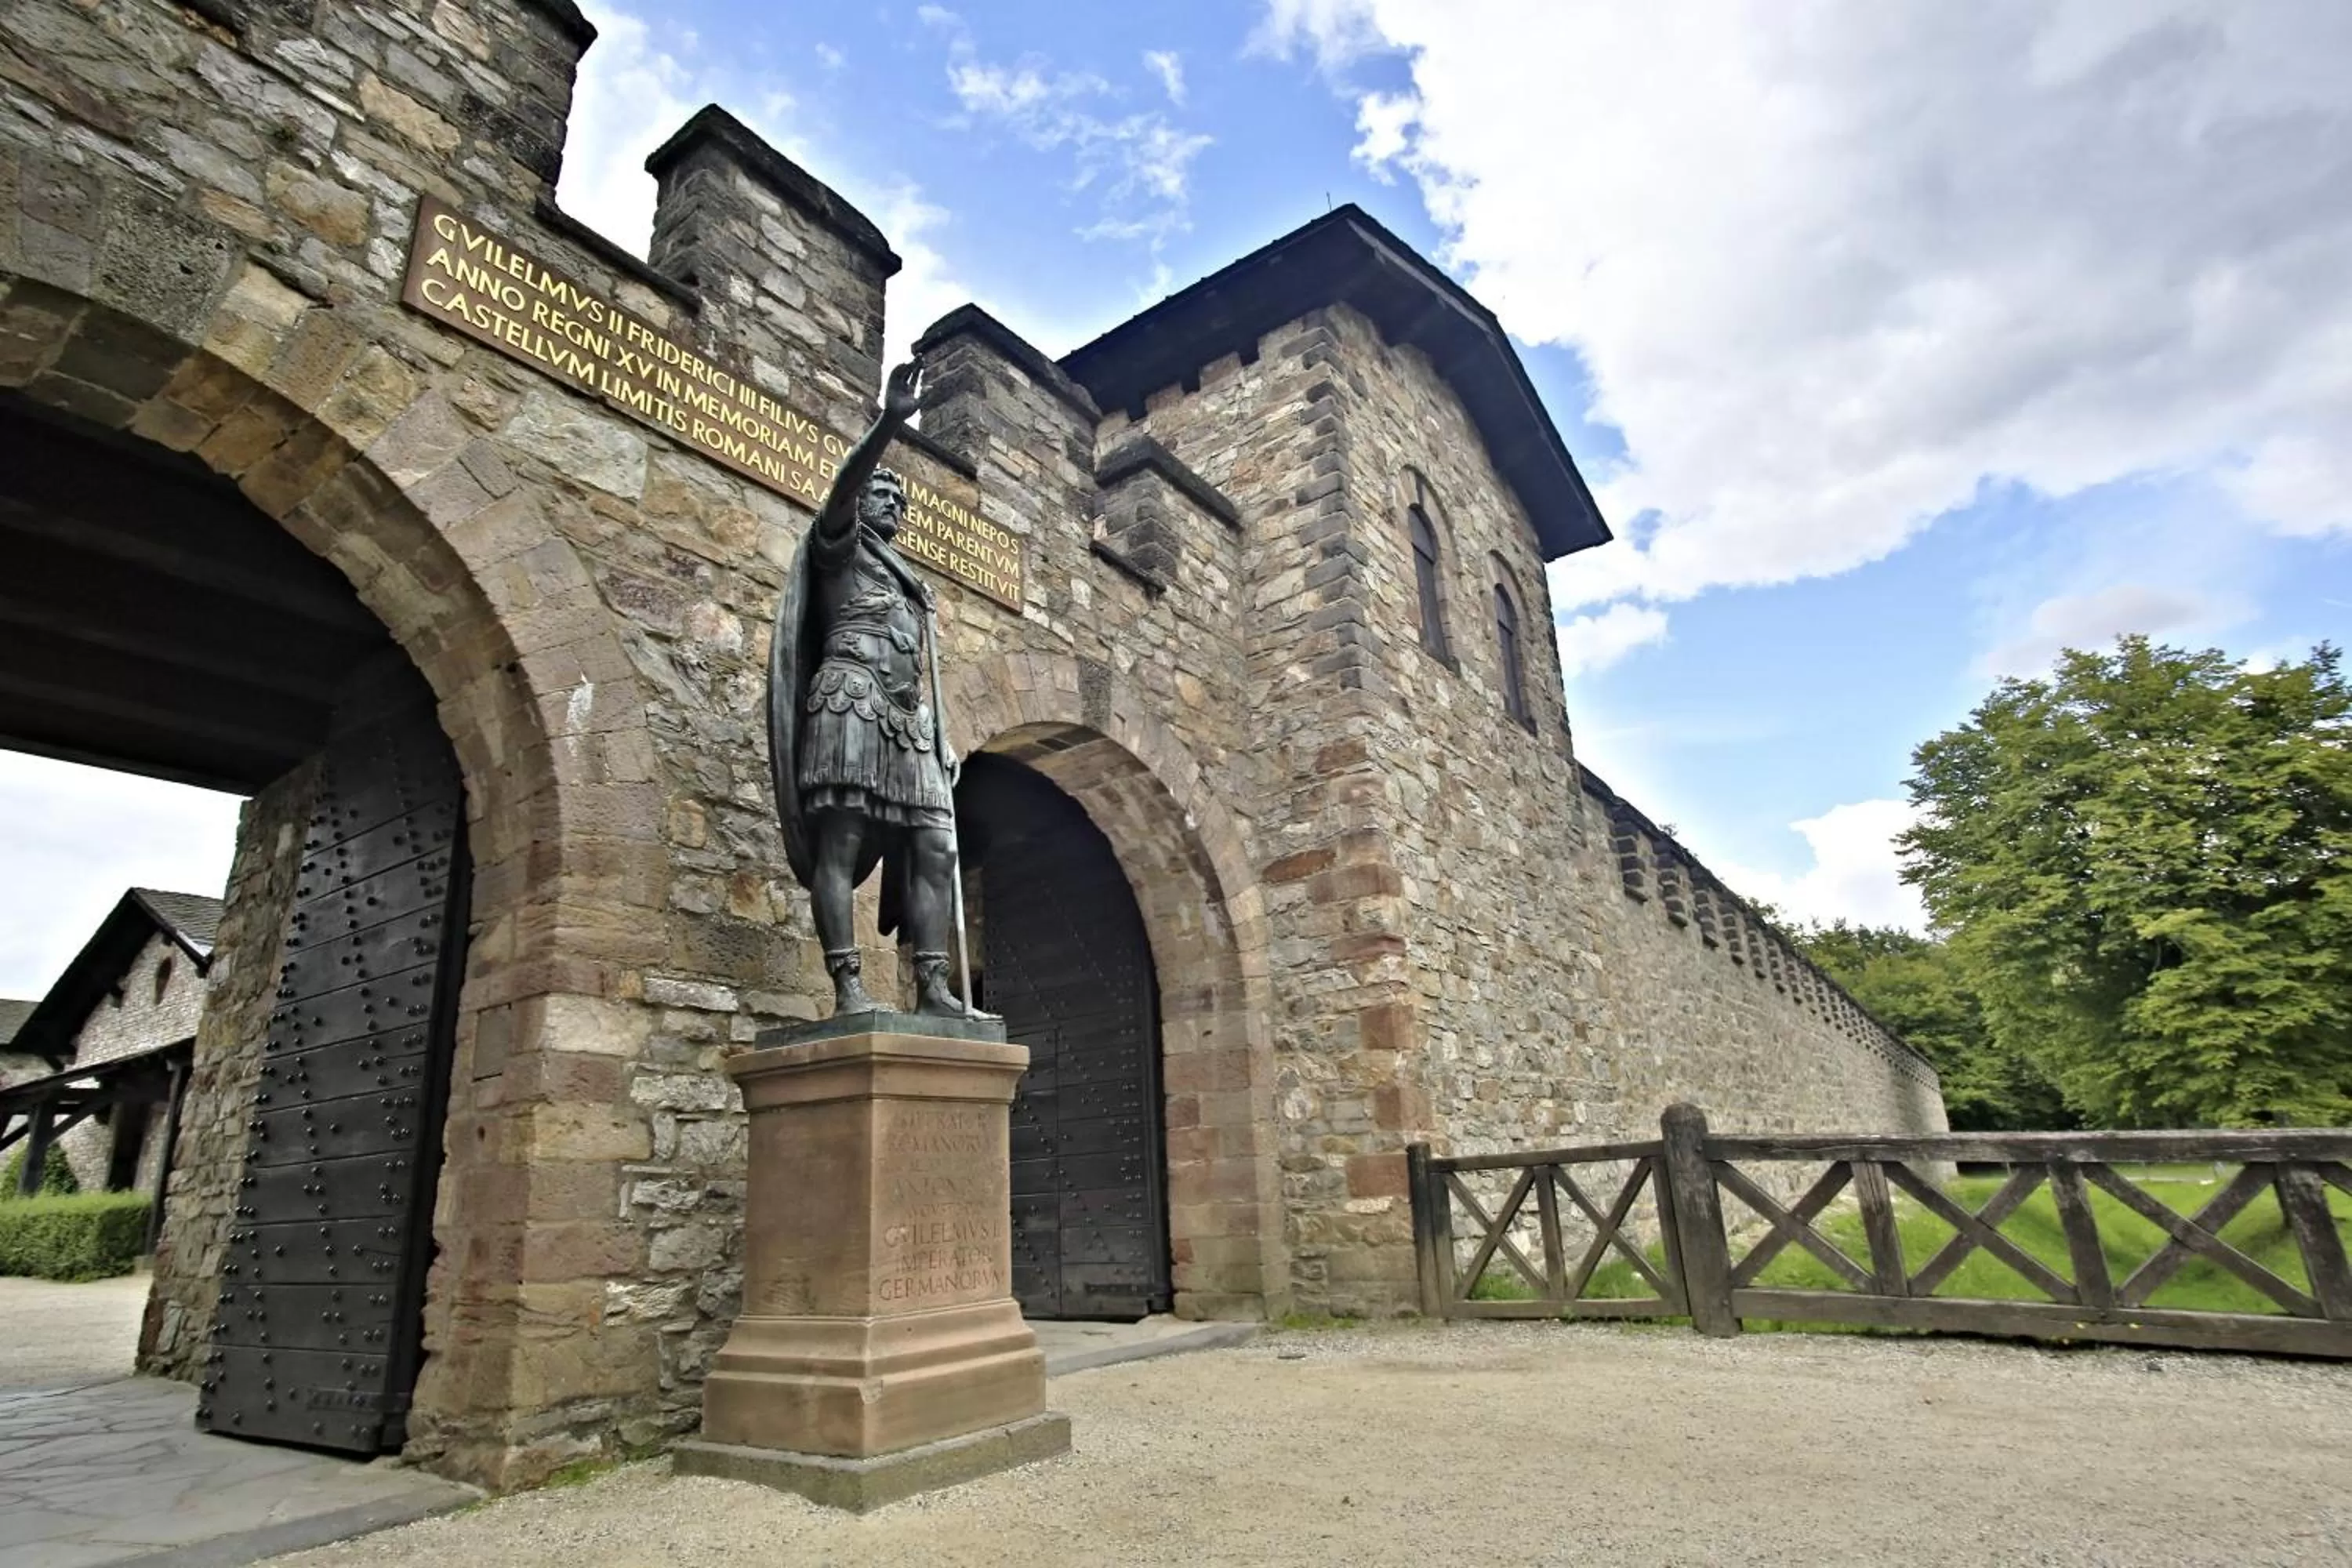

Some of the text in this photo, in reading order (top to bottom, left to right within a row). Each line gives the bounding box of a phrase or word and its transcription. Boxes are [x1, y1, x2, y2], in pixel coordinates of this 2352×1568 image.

[421, 278, 595, 386] CASTELLVM
[601, 372, 686, 432] LIMITIS
[691, 419, 785, 482] ROMANI
[950, 553, 1018, 603] RESTITVIT
[426, 246, 526, 312] ANNO
[532, 300, 611, 361] REGNI
[615, 346, 655, 376] XV
[656, 367, 680, 398] IN
[684, 384, 814, 470] MEMORIAM
[937, 521, 1018, 579] PARENTVM
[433, 213, 604, 324] GVILELMVS
[608, 310, 623, 336] II
[628, 322, 734, 397] FRIDERICI
[739, 383, 757, 410] III
[759, 395, 818, 442] FILIVS
[910, 482, 967, 528] MAGNI
[970, 514, 1018, 553] NEPOS
